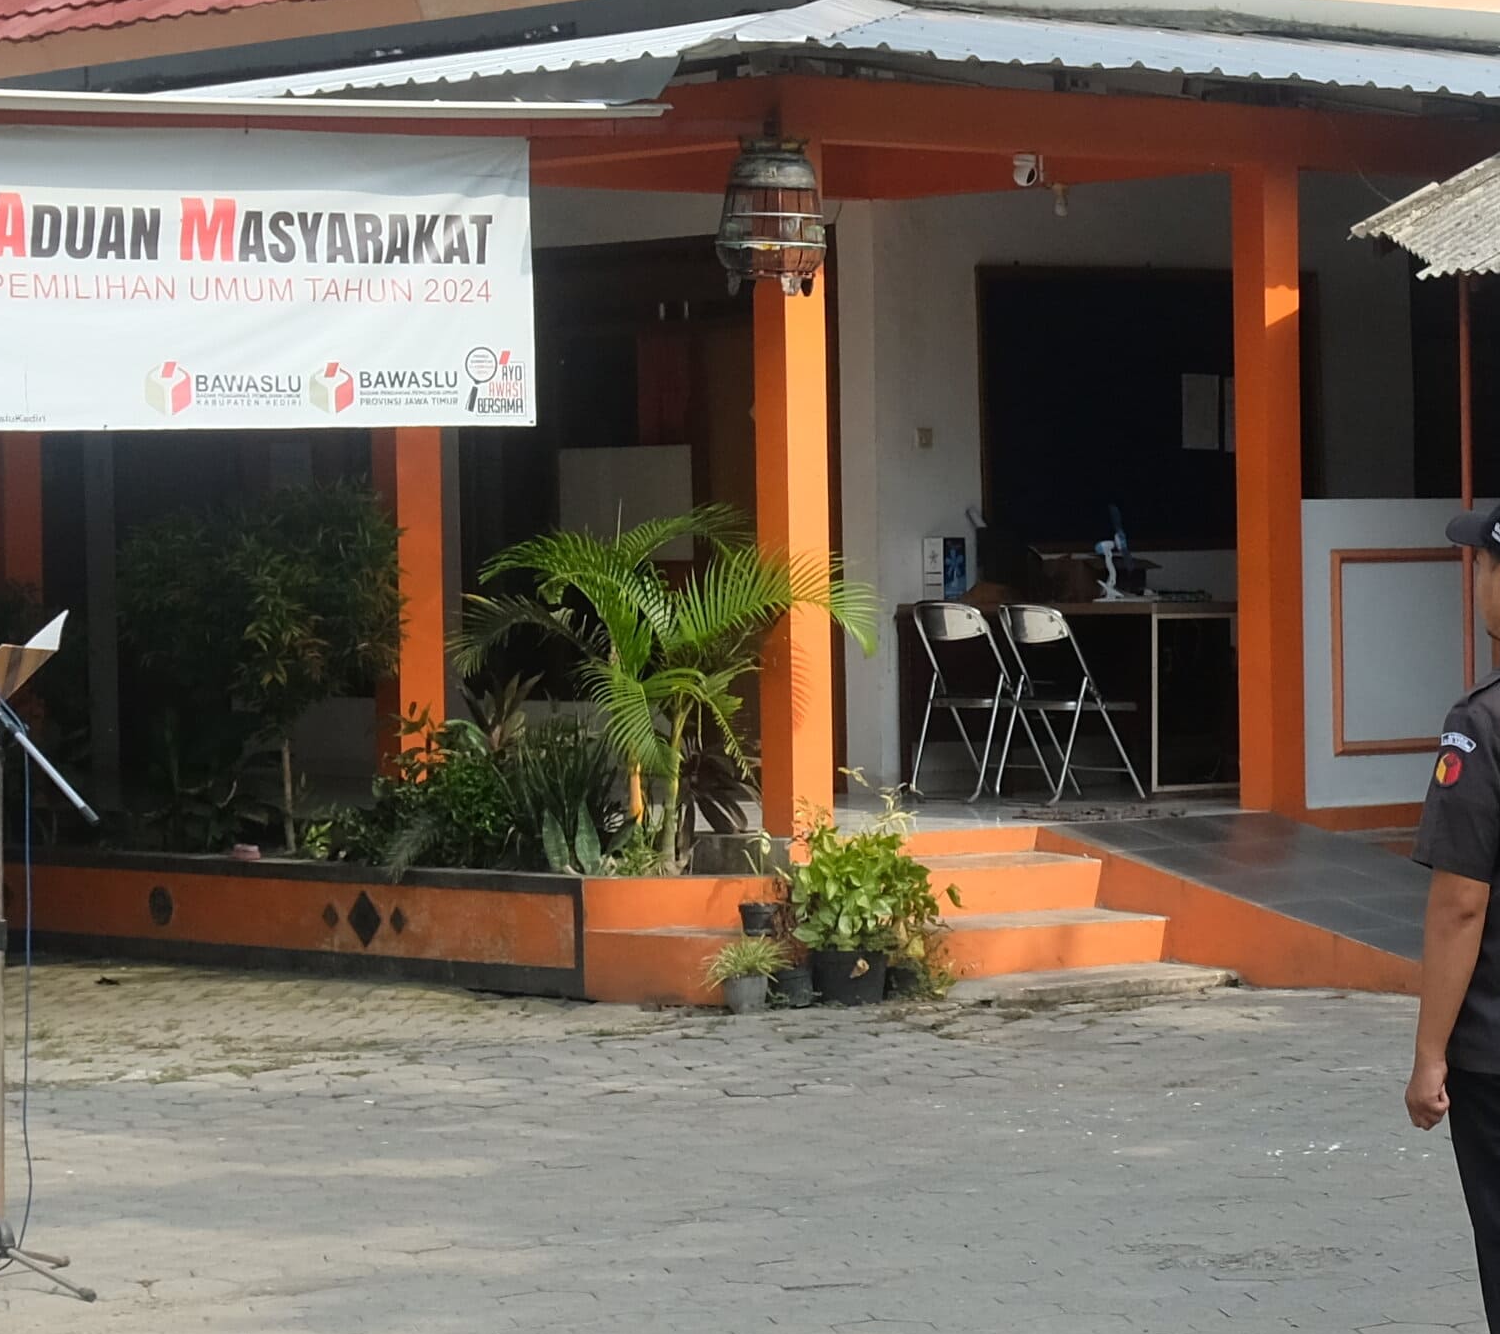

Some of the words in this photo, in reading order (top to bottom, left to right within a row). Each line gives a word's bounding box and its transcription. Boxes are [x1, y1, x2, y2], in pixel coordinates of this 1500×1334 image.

[179, 197, 493, 265] MASYARAKAT
[189, 276, 294, 303] UMUM
[305, 277, 412, 303] TAHUN
[424, 278, 493, 303] 2024
[359, 370, 458, 389] BAWASLU
[501, 364, 523, 381] AYO
[195, 374, 302, 393] BAWASLU
[488, 381, 523, 398] AWASI
[265, 399, 302, 407] KEDIRI
[360, 397, 402, 406] PROVINSI
[404, 397, 429, 406] JAWA
[431, 397, 459, 406] TIMUR
[477, 398, 524, 414] BERSAMA
